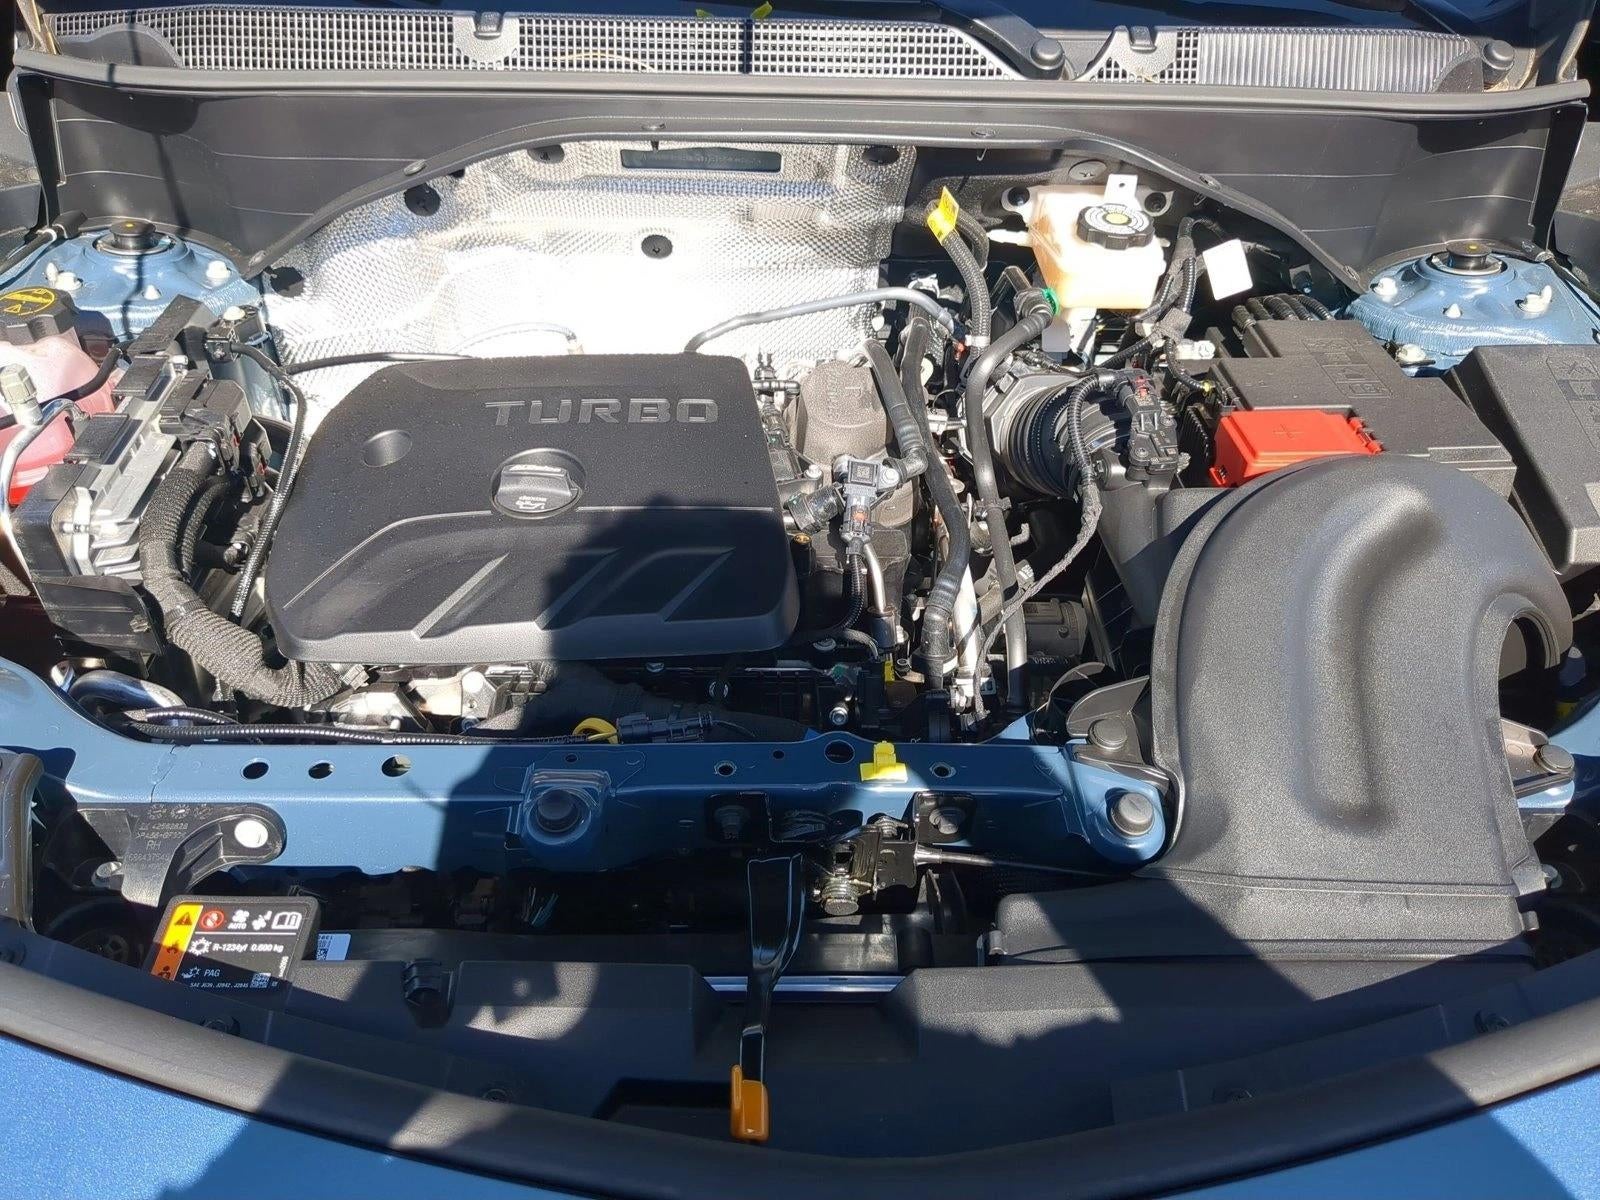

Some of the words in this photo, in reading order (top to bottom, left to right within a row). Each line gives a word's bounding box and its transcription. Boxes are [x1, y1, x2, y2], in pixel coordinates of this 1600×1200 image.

[485, 398, 718, 426] TURBO
[146, 840, 161, 850] RH
[228, 922, 247, 930] AUTO
[212, 943, 247, 953] R-1234yf
[273, 943, 284, 953] kg
[203, 968, 221, 977] PAG
